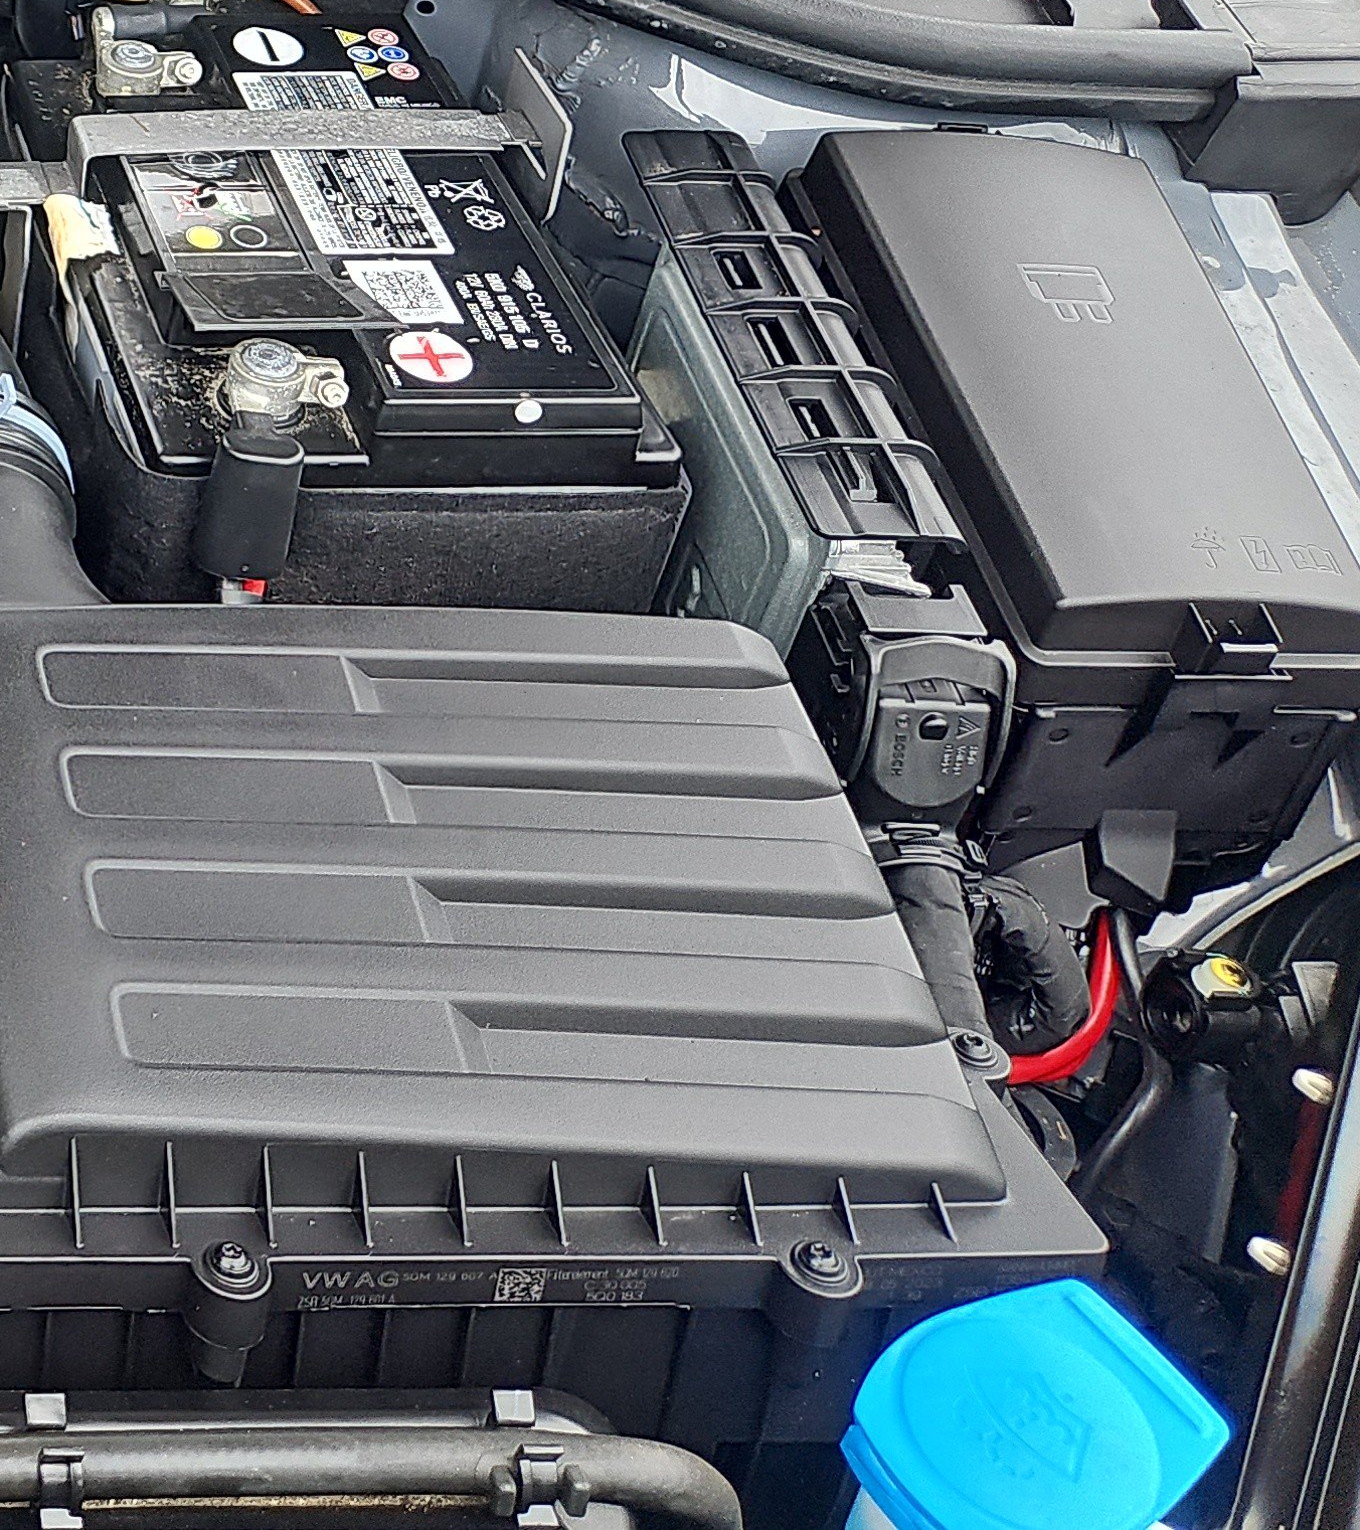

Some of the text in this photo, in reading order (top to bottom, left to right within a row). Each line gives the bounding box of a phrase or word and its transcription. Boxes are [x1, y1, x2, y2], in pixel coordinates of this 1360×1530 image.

[525, 290, 573, 355] CLARIOS
[521, 335, 540, 350] D
[302, 1272, 350, 1288] VW
[355, 1271, 399, 1288] AG
